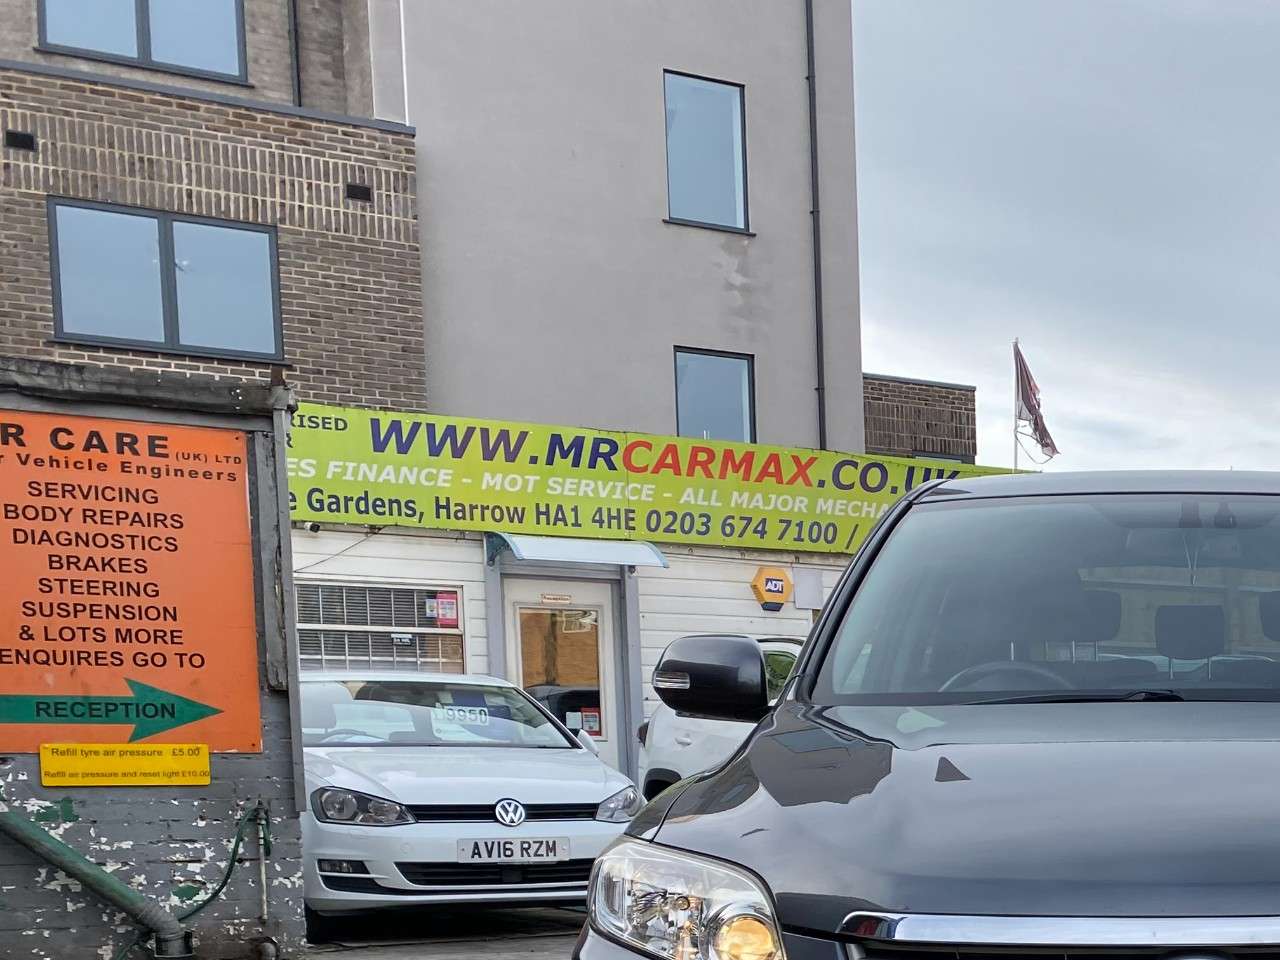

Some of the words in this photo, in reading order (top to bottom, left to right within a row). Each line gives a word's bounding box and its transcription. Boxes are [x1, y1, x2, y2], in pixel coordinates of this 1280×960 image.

[49, 426, 170, 458] CARE
[175, 451, 208, 464] (UK)
[215, 453, 242, 465] LTD
[16, 452, 108, 472] Vehicle
[120, 460, 238, 482] Engineers
[27, 479, 160, 505] SERVICING
[326, 460, 453, 488] FINANCE
[481, 472, 541, 494] MOT
[546, 478, 655, 502] SERVICE
[679, 487, 722, 507] ALL
[730, 491, 809, 514] MAJOR
[4, 503, 74, 523] BODY
[81, 507, 185, 530] REPAIRS
[306, 487, 425, 524] Gardens,
[434, 496, 526, 525] Harrow
[535, 502, 583, 529] HA1
[591, 506, 636, 532] 4HE
[645, 509, 711, 537] 0203
[720, 514, 768, 541] 674
[777, 519, 838, 545] 7100
[12, 528, 179, 553] DIAGNOSTICS
[47, 553, 149, 574] BRAKES
[37, 577, 160, 598] STEERING
[765, 579, 784, 592] ADT
[21, 600, 178, 622] SUSPENSION
[18, 624, 36, 641] &
[44, 625, 107, 644] LOTS
[115, 628, 184, 646] MORE
[0, 648, 125, 668] ENQUIRES
[131, 650, 167, 669] GO
[174, 652, 206, 669] TO
[35, 701, 177, 720] RECEPTION
[51, 748, 77, 757] Refill
[81, 748, 100, 759] tyre
[103, 749, 116, 757] air
[119, 749, 163, 759] pressure
[172, 748, 200, 757] £5.00
[82, 771, 119, 780] pressure
[122, 770, 137, 778] and
[139, 770, 160, 778] reset
[163, 770, 180, 780] light
[470, 840, 514, 859] AV16
[520, 839, 557, 858] RZM
